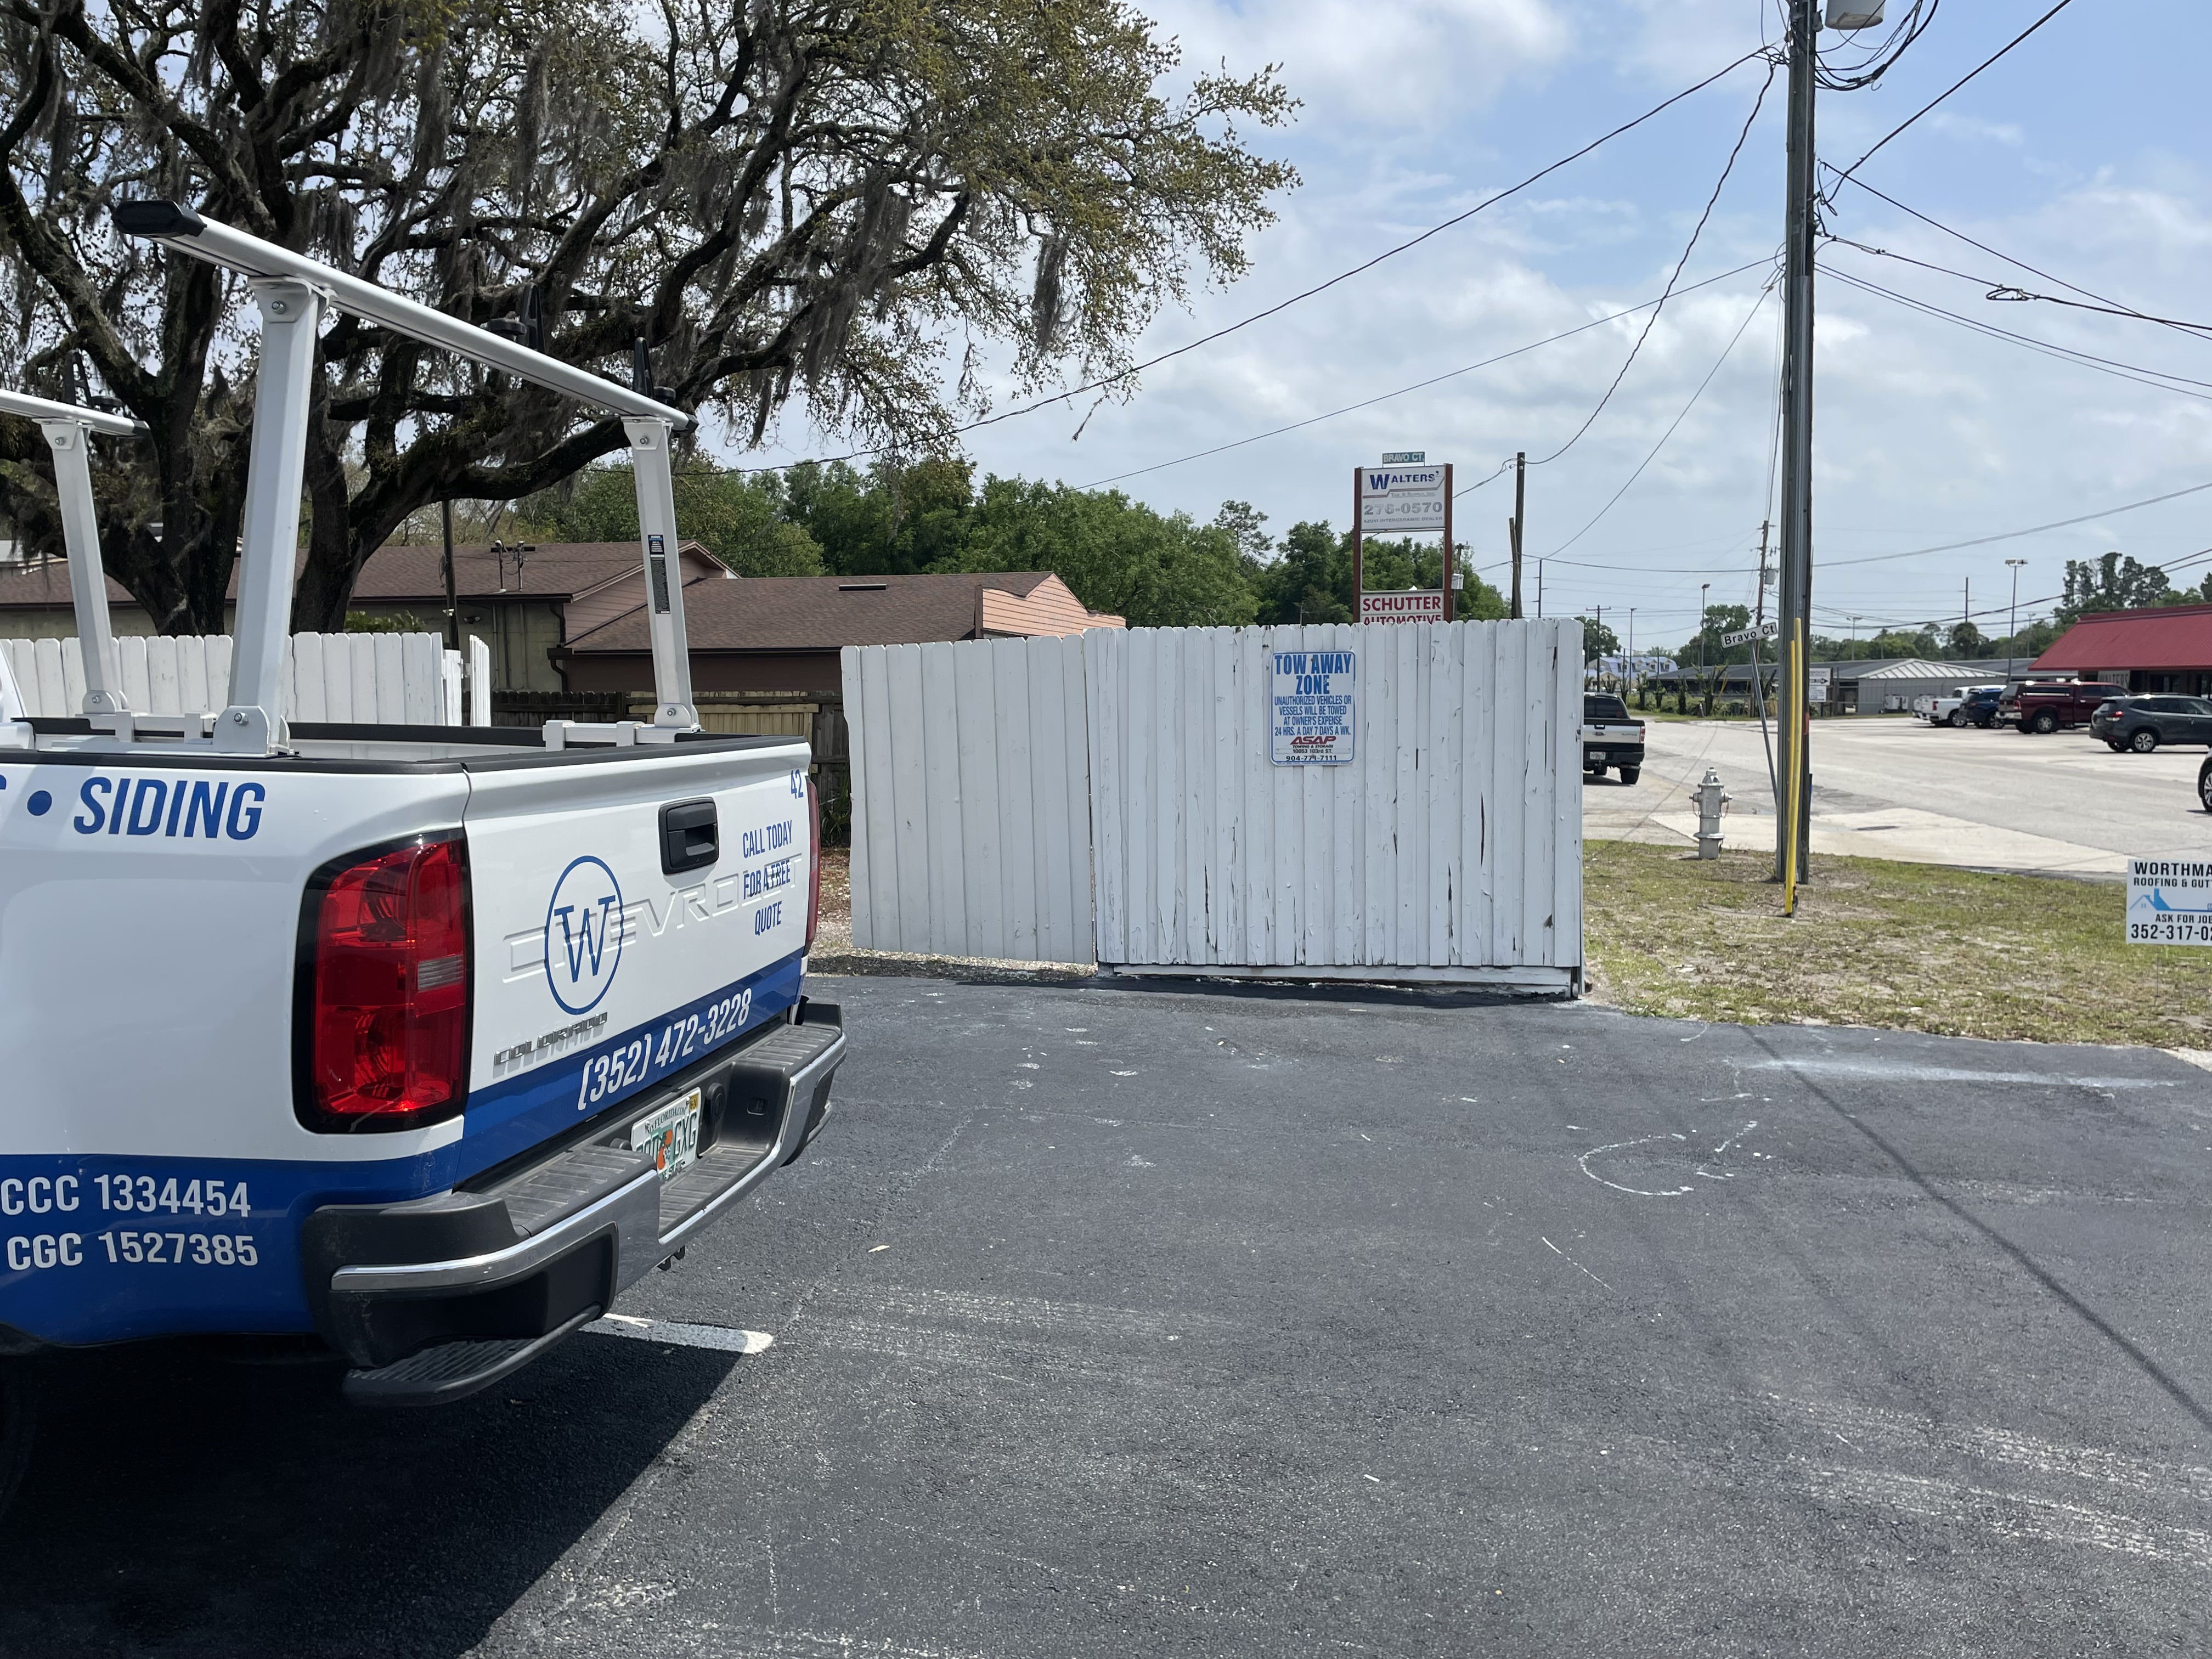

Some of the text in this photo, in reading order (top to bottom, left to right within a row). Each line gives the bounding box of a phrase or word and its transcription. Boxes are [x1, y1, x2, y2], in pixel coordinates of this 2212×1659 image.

[1383, 453, 1409, 462] BRAVO
[1364, 501, 1442, 515] 276-0570
[1363, 596, 1441, 611] SCHUTTER
[1724, 625, 1774, 645] Bravo Ct
[1274, 653, 1352, 675] TOW AWAY
[1296, 674, 1330, 695] ZONE
[1274, 695, 1352, 706] UNAUTHORIZED VEHICLES OR
[1279, 706, 1347, 715] VESSELS WILL BE TOWED
[1275, 726, 1351, 736] 24 HRS. A DAY 7 DAYS A WK.
[1284, 716, 1342, 726] AT OWNER'S EXPENSE
[1290, 736, 1336, 745] ASAP
[791, 769, 804, 799] 42
[74, 776, 266, 840] SIDING
[743, 820, 792, 859] CALL TODAY
[743, 859, 791, 900] FOR A FREE
[2135, 862, 2212, 877] WORTHMA
[2134, 877, 2212, 888] ROOFING & GUT
[754, 900, 782, 936] QUOTE
[2155, 914, 2174, 923] ASK
[2177, 915, 2194, 923] FOR
[554, 895, 616, 983] W
[2131, 924, 2212, 941] 352-317-0
[494, 1012, 608, 1065] COLORADO
[577, 988, 752, 1110] (352) 472-3228
[1, 1174, 251, 1217] CCC 1334454
[7, 1231, 258, 1271] CGC 1527385
